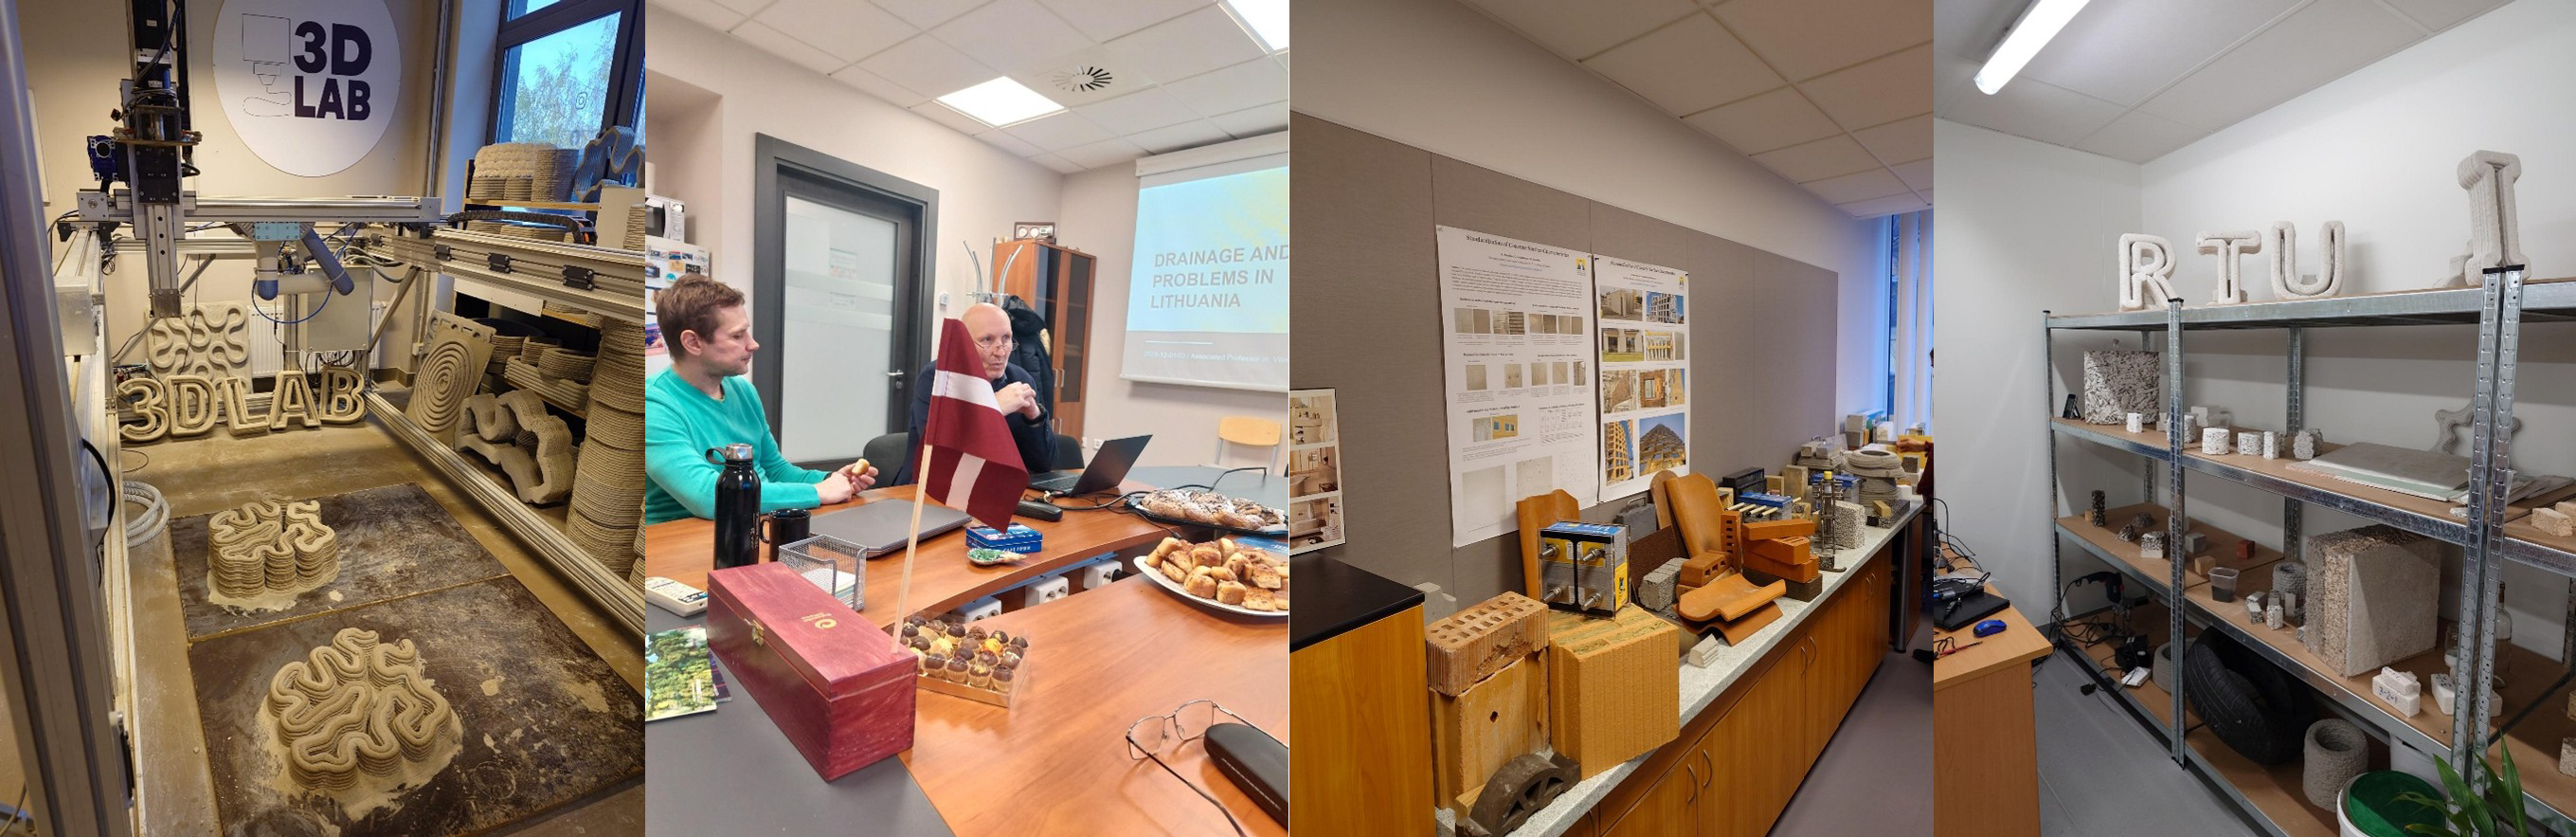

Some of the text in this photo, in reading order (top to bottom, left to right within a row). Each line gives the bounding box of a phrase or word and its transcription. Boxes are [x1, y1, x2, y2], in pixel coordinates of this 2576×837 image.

[293, 21, 372, 77] 3D
[295, 76, 370, 120] LAB
[1154, 245, 1288, 267] DRAINAGE AND
[1152, 269, 1274, 288] PROBLEMS IN
[1150, 293, 1241, 309] LITHUANIA
